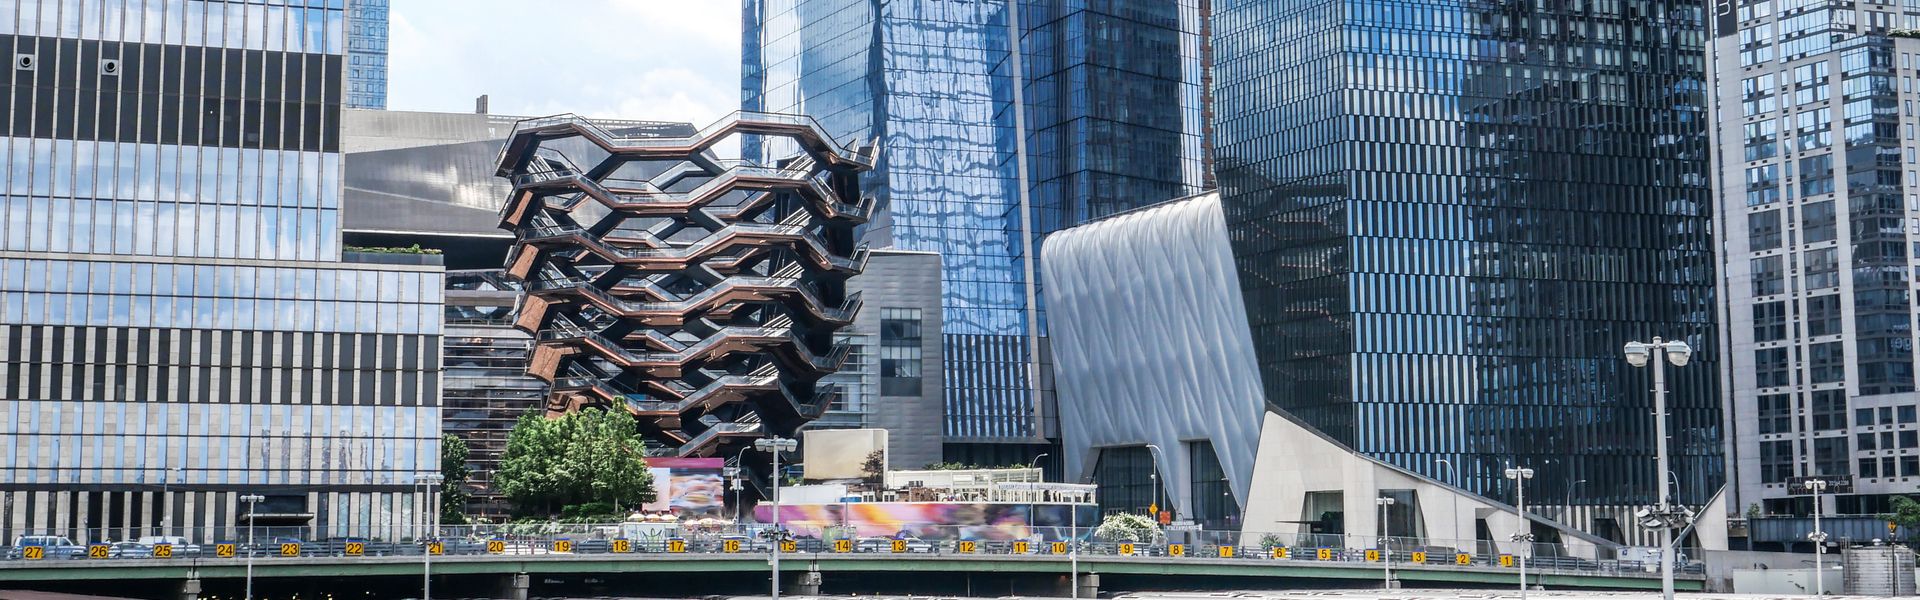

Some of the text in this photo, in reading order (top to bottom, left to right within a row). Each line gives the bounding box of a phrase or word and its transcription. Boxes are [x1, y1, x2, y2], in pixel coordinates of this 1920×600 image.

[218, 545, 232, 556] 24
[283, 544, 298, 554] 23
[347, 544, 362, 554] 22
[429, 542, 441, 553] 21
[490, 542, 504, 552] 20
[556, 541, 569, 551] 19
[614, 541, 628, 551] 18
[670, 541, 683, 551] 17
[726, 541, 739, 551] 16
[782, 541, 795, 550] 15
[836, 541, 848, 550] 14
[893, 541, 904, 550] 13
[961, 542, 974, 552] 12
[1016, 542, 1026, 552] 11
[1053, 542, 1065, 553] 10
[1124, 544, 1130, 554] 9
[1173, 545, 1180, 554] 8
[25, 547, 42, 558] 27
[91, 546, 107, 558] 26
[155, 546, 170, 558] 25
[1223, 547, 1229, 556] 7
[1276, 548, 1282, 558] 6
[1321, 550, 1328, 558] 5
[1369, 551, 1375, 560] 4
[1416, 552, 1422, 562] 3
[1460, 554, 1466, 564] 2
